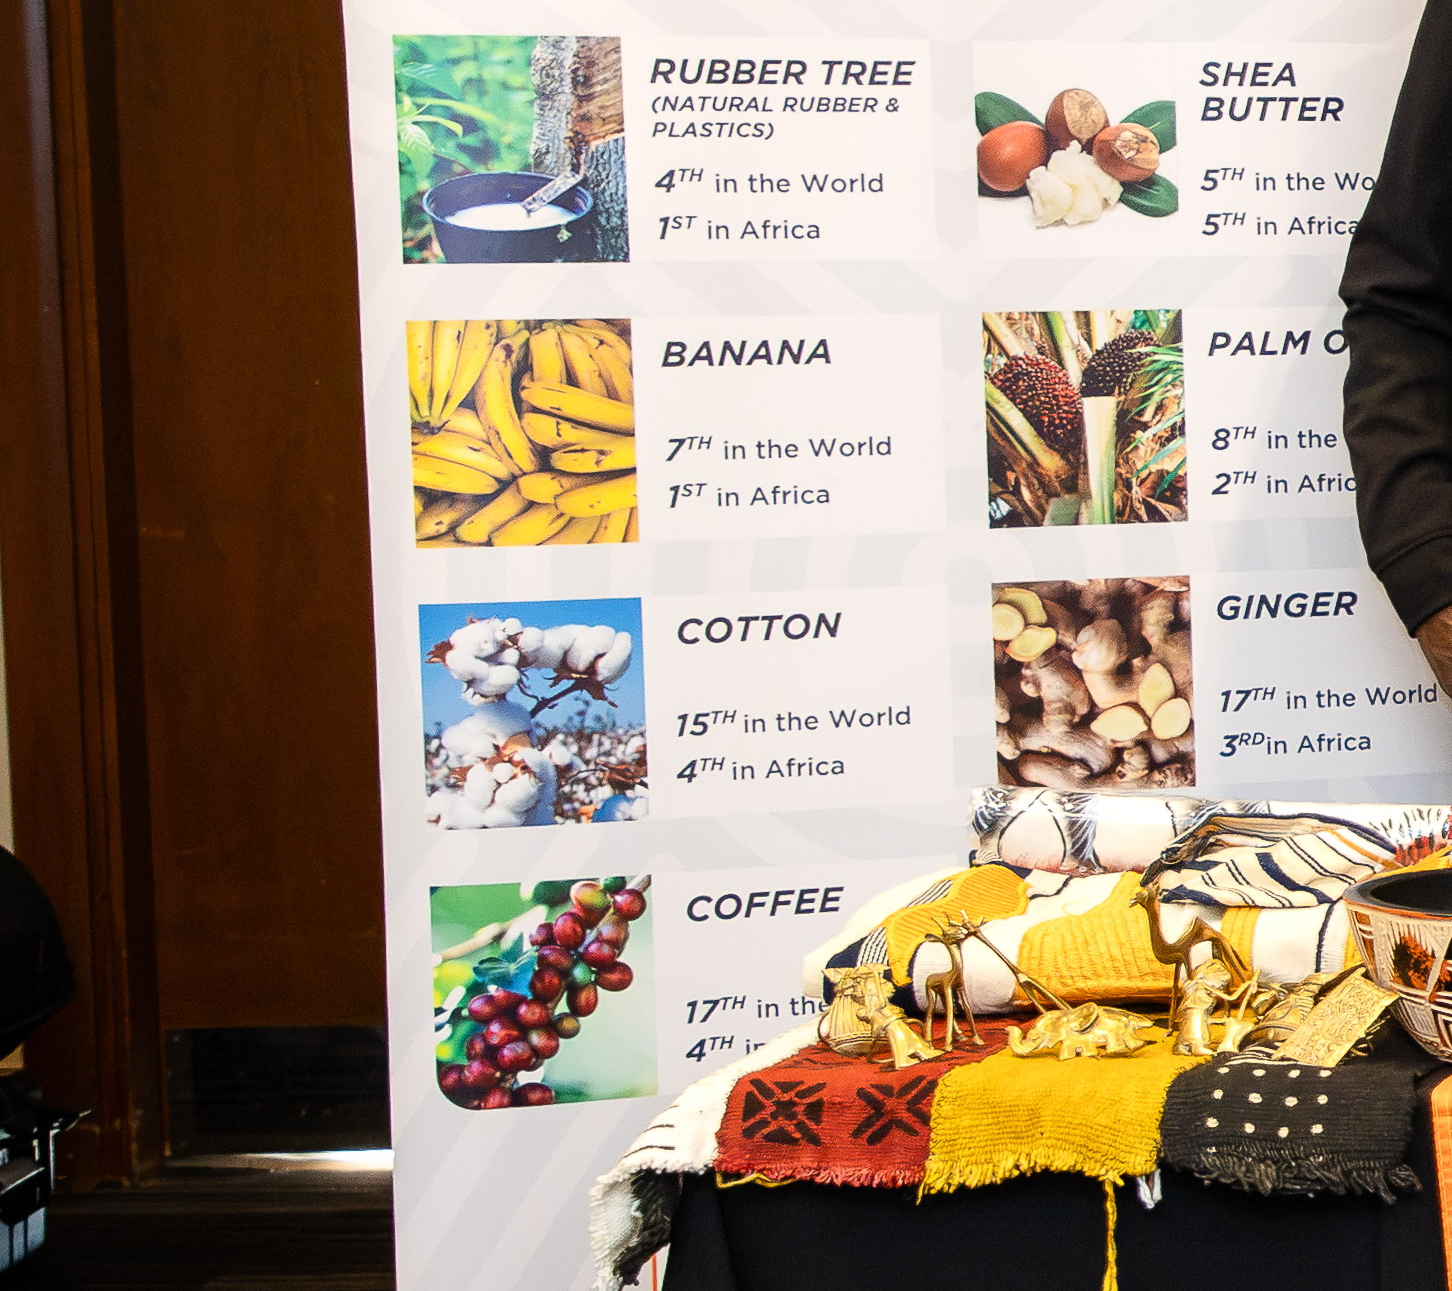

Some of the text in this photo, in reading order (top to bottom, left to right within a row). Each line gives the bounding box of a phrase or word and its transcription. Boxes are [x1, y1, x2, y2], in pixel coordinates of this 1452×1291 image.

[650, 59, 916, 85] RUBBER TREE
[1199, 62, 1296, 87] SHEA
[652, 96, 901, 113] (NATURAL RUBBER &
[1201, 97, 1344, 121] BUTTER
[652, 122, 774, 140] PLASTICS)
[1201, 168, 1244, 191] 5TH
[1256, 173, 1275, 191] in
[1286, 172, 1325, 191] the
[1202, 213, 1246, 236] 5TH
[1257, 217, 1277, 235] in
[662, 339, 831, 367] BANANA
[1208, 331, 1311, 356] PALM
[1212, 427, 1337, 450] 8TH in the
[1212, 471, 1358, 496] 2TH in Afric
[1217, 592, 1357, 620] GINGER
[678, 613, 841, 644] COTTON
[1221, 683, 1437, 712] 17TH in the World
[687, 887, 844, 921] COFFEE
[687, 996, 746, 1024] 17TH
[757, 1000, 779, 1018] in
[686, 1036, 734, 1062] 4TH
